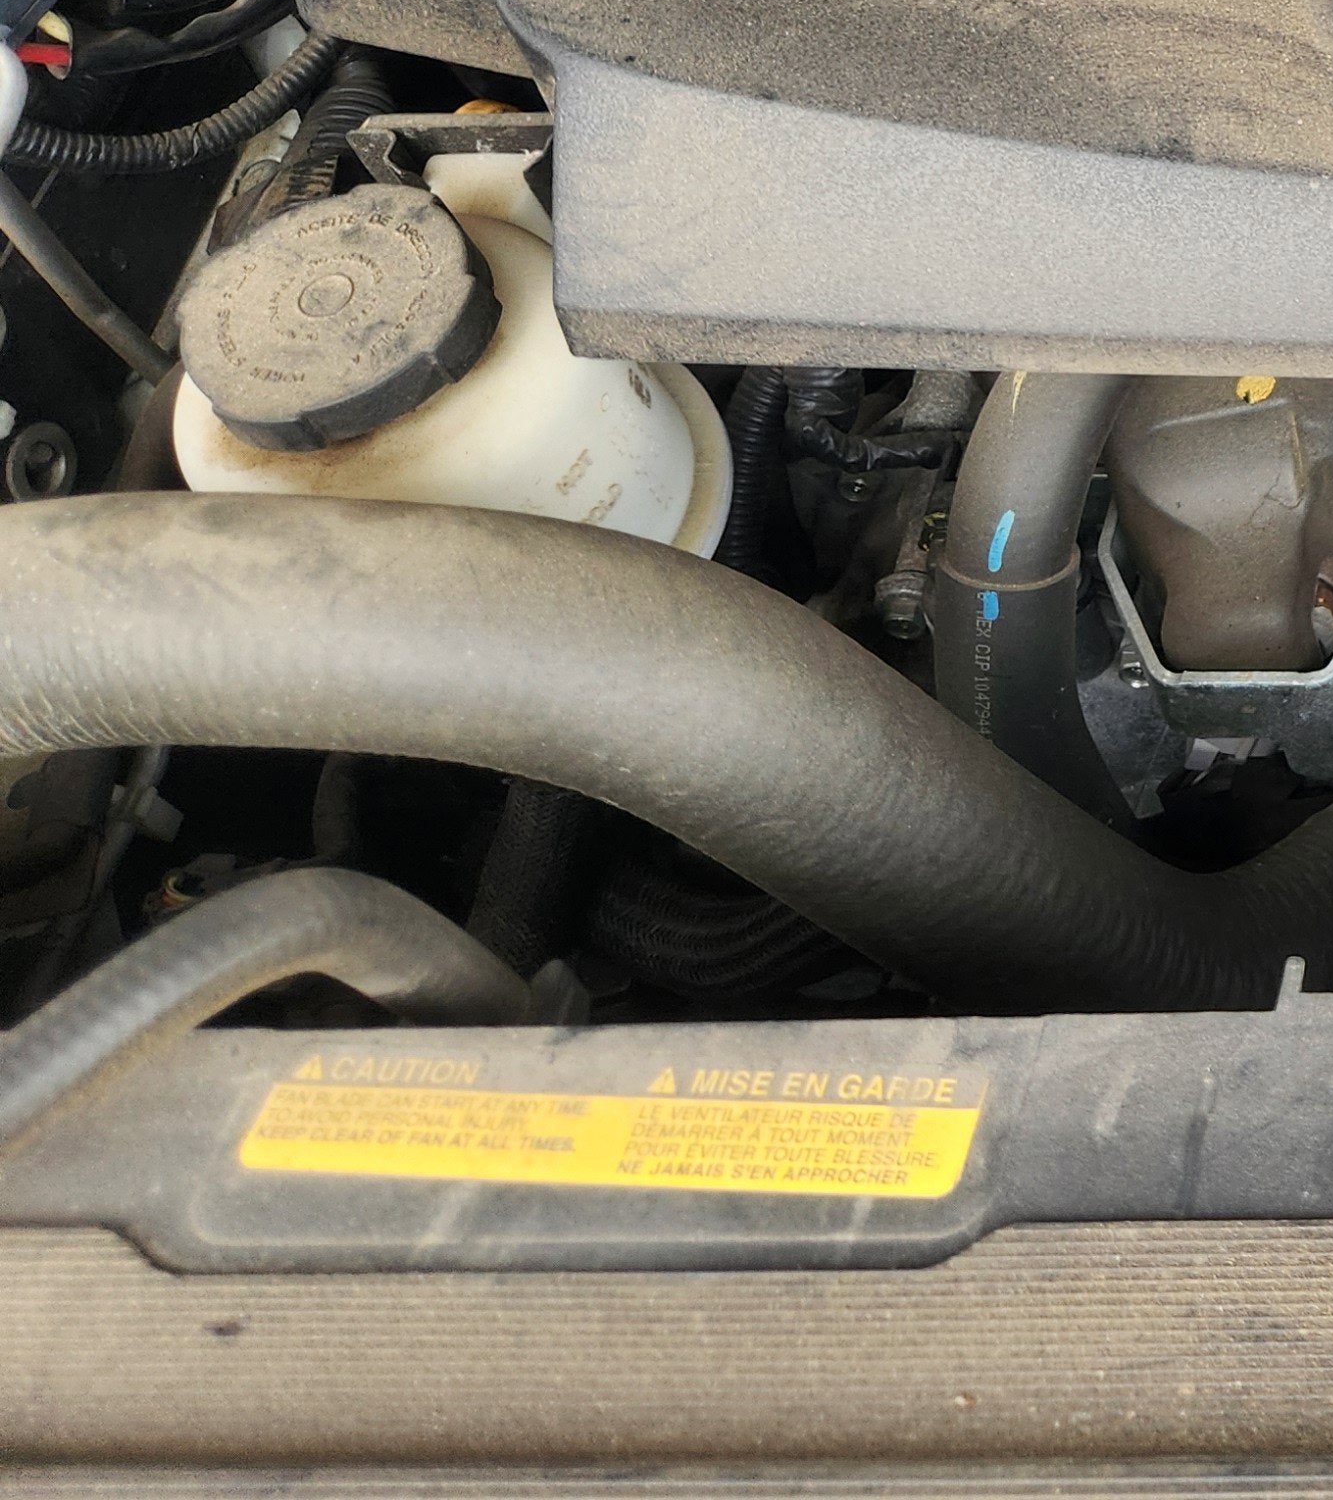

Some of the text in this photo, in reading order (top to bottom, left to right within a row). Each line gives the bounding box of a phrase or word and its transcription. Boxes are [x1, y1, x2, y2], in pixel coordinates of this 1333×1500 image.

[331, 1056, 483, 1083] CAUTION
[690, 1068, 958, 1103] MISE EN GARDE
[637, 1104, 663, 1120] LE
[671, 1105, 803, 1124] VENTILATEUR
[808, 1110, 885, 1128] RISQUE
[770, 1126, 821, 1144] TOUT
[763, 1145, 829, 1163] TOUTE
[615, 1159, 645, 1175] NE
[648, 1161, 725, 1178] JAMAIS
